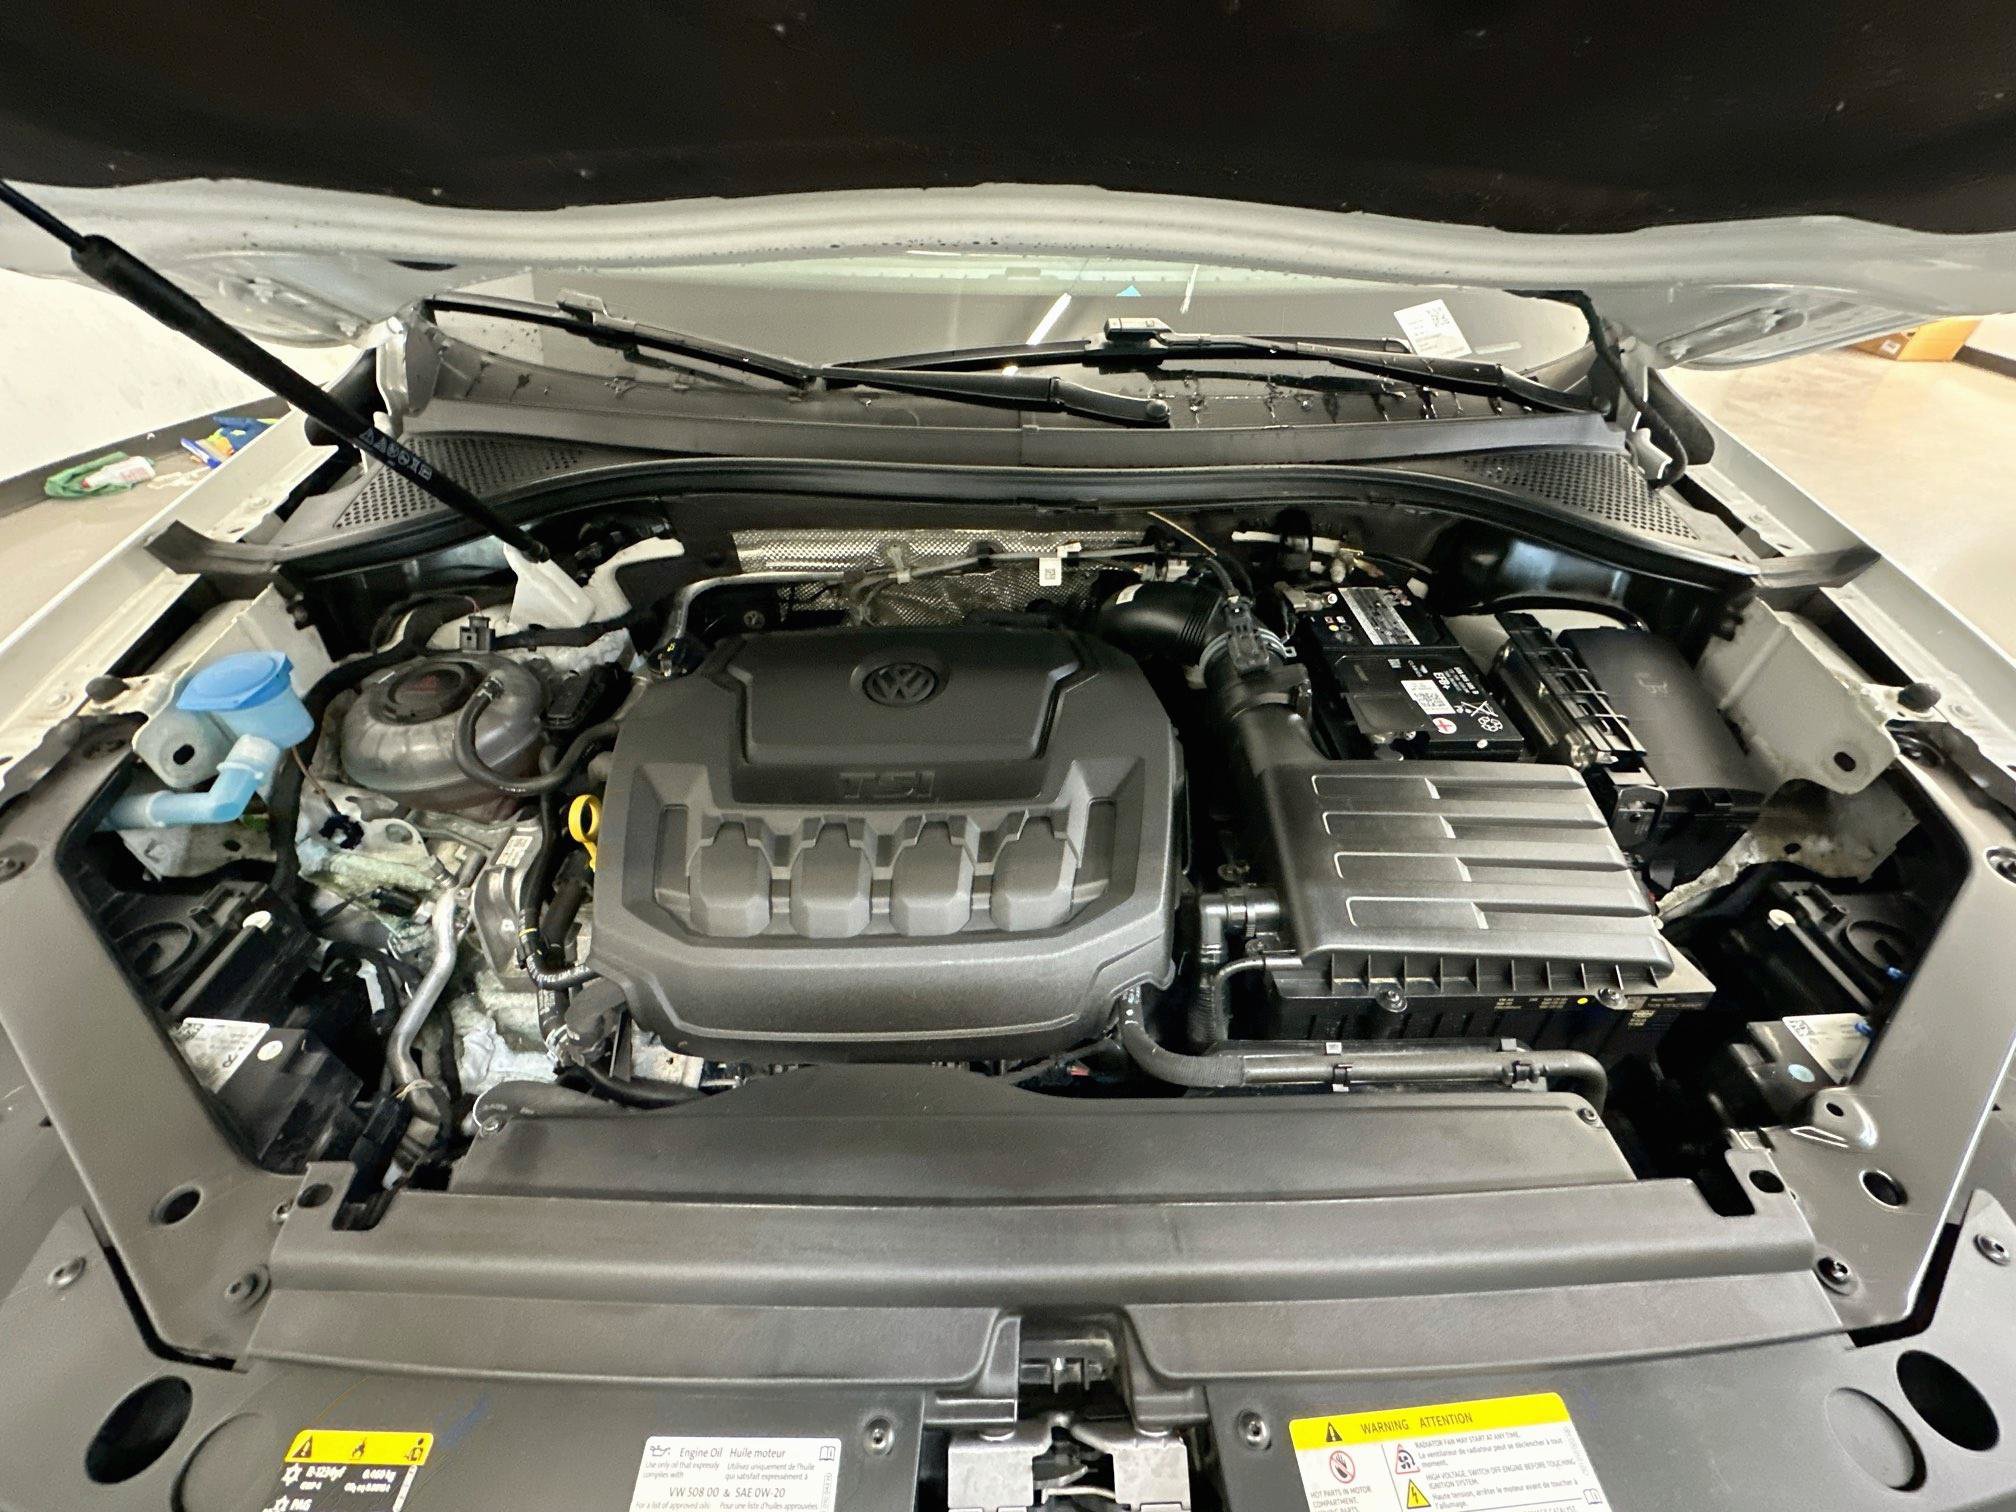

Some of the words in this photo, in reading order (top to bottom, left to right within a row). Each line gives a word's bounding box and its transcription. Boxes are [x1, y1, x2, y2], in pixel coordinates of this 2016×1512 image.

[839, 770, 936, 799] TSI
[1360, 1418, 1409, 1435] WARNING
[1420, 1412, 1473, 1429] ATTENTION
[1469, 1434, 1485, 1442] START
[680, 1448, 708, 1460] Engine
[710, 1447, 723, 1457] Oil
[729, 1447, 752, 1458] Huile
[754, 1448, 786, 1458] moteur
[1467, 1445, 1492, 1453] radiateur
[1493, 1443, 1507, 1452] peut
[657, 1462, 670, 1470] only
[692, 1462, 720, 1470] expressly
[750, 1463, 787, 1471] uniquement
[1467, 1468, 1490, 1476] SWITCH
[1490, 1466, 1502, 1474] OFF
[1503, 1464, 1524, 1473] ENGINE
[1524, 1461, 1546, 1471] BEFORE
[643, 1472, 668, 1480] complies
[725, 1473, 735, 1482] qui
[1429, 1481, 1455, 1489] IGNITION
[1503, 1483, 1524, 1492] moteur
[1525, 1482, 1542, 1490] avant
[1550, 1479, 1573, 1488] toucher
[669, 1487, 686, 1497] VW
[687, 1487, 705, 1497] 508
[706, 1487, 719, 1497] 00
[723, 1488, 730, 1497] &
[735, 1487, 753, 1498] SAE
[754, 1487, 786, 1498] 0W-20
[1311, 1490, 1323, 1498] HOT
[1324, 1488, 1342, 1497] PARTS
[1349, 1486, 1372, 1494] MOTOR
[669, 1502, 698, 1510] approved
[760, 1502, 783, 1510] d'huiles
[784, 1503, 818, 1511] approuvées
